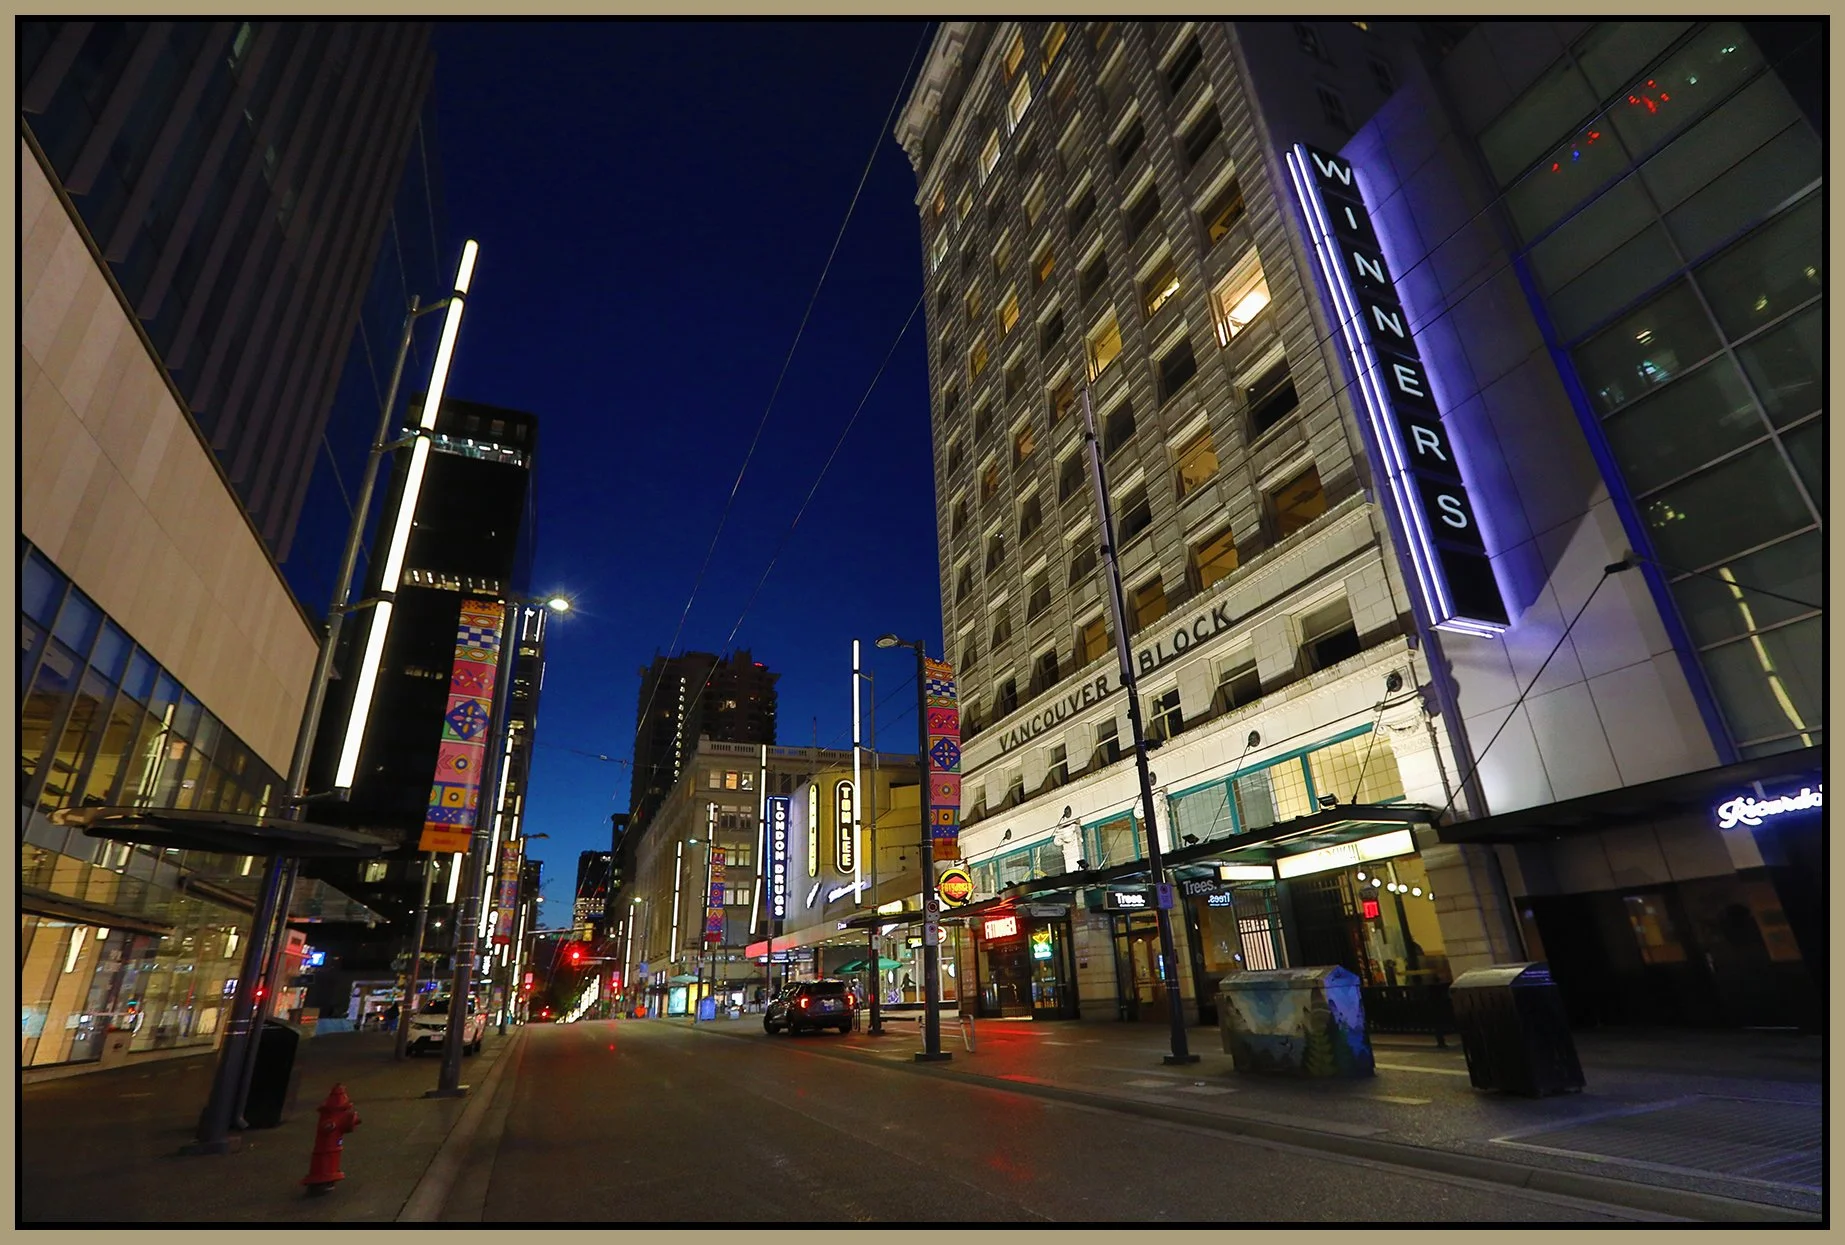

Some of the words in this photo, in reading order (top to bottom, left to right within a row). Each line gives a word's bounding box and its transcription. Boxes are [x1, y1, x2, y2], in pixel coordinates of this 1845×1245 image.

[1312, 152, 1467, 528] WINNERS
[1000, 674, 1110, 752] VANCOUVER
[1138, 600, 1232, 676] BLOCK
[841, 787, 852, 824] TOM
[774, 801, 785, 861] LONDON
[841, 828, 852, 866] LEE
[774, 864, 784, 916] DRUGS
[1114, 892, 1146, 904] Trees.
[1182, 879, 1217, 895] Trees.
